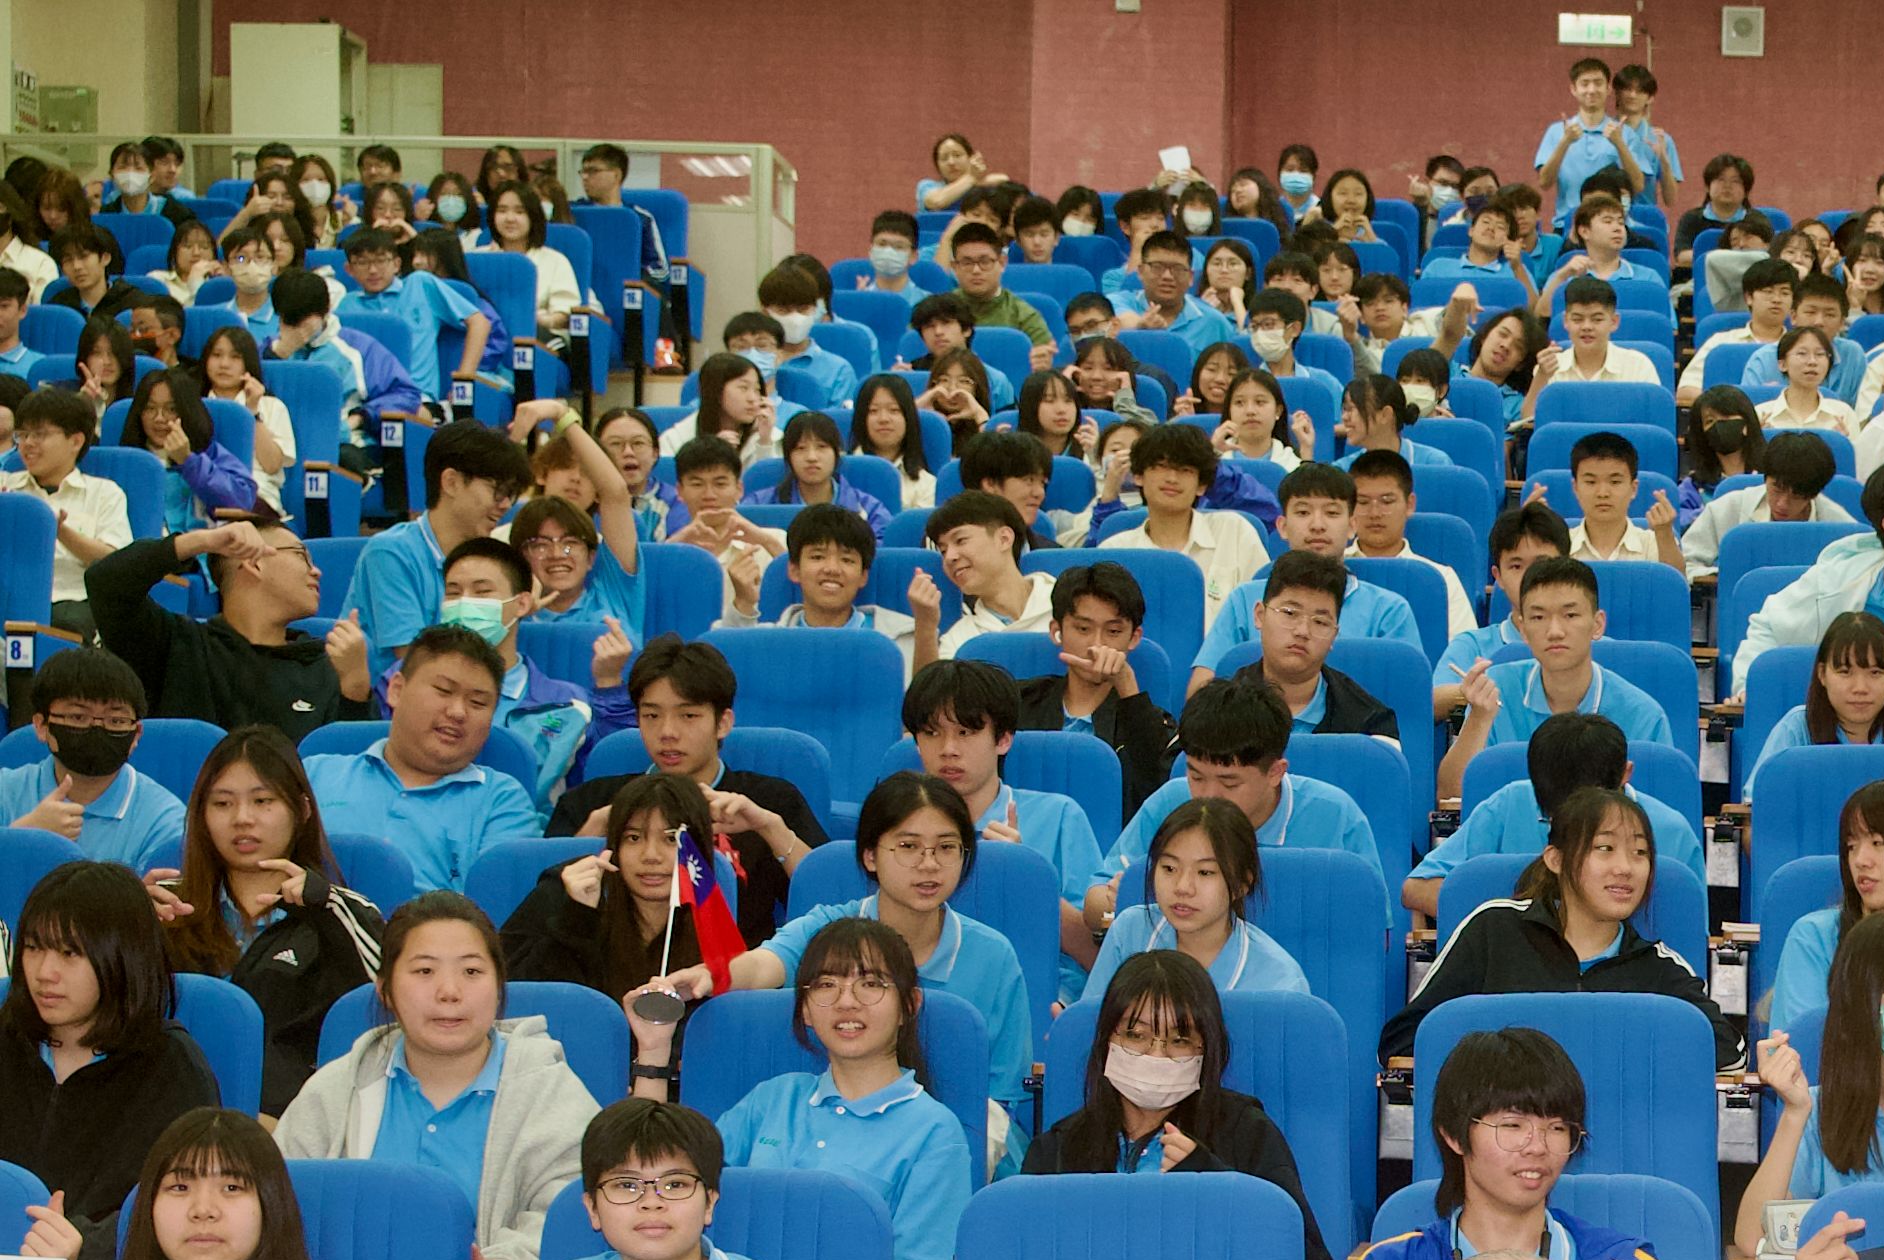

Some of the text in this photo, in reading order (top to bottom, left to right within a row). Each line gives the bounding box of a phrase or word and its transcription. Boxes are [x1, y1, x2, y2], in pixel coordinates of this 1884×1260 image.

[672, 267, 682, 282] 17
[625, 292, 637, 306] 16
[572, 318, 583, 332] 15
[517, 351, 527, 366] 14
[456, 386, 466, 401] 13
[385, 426, 397, 442] 12
[309, 477, 318, 493] 11
[11, 640, 21, 660] 8
